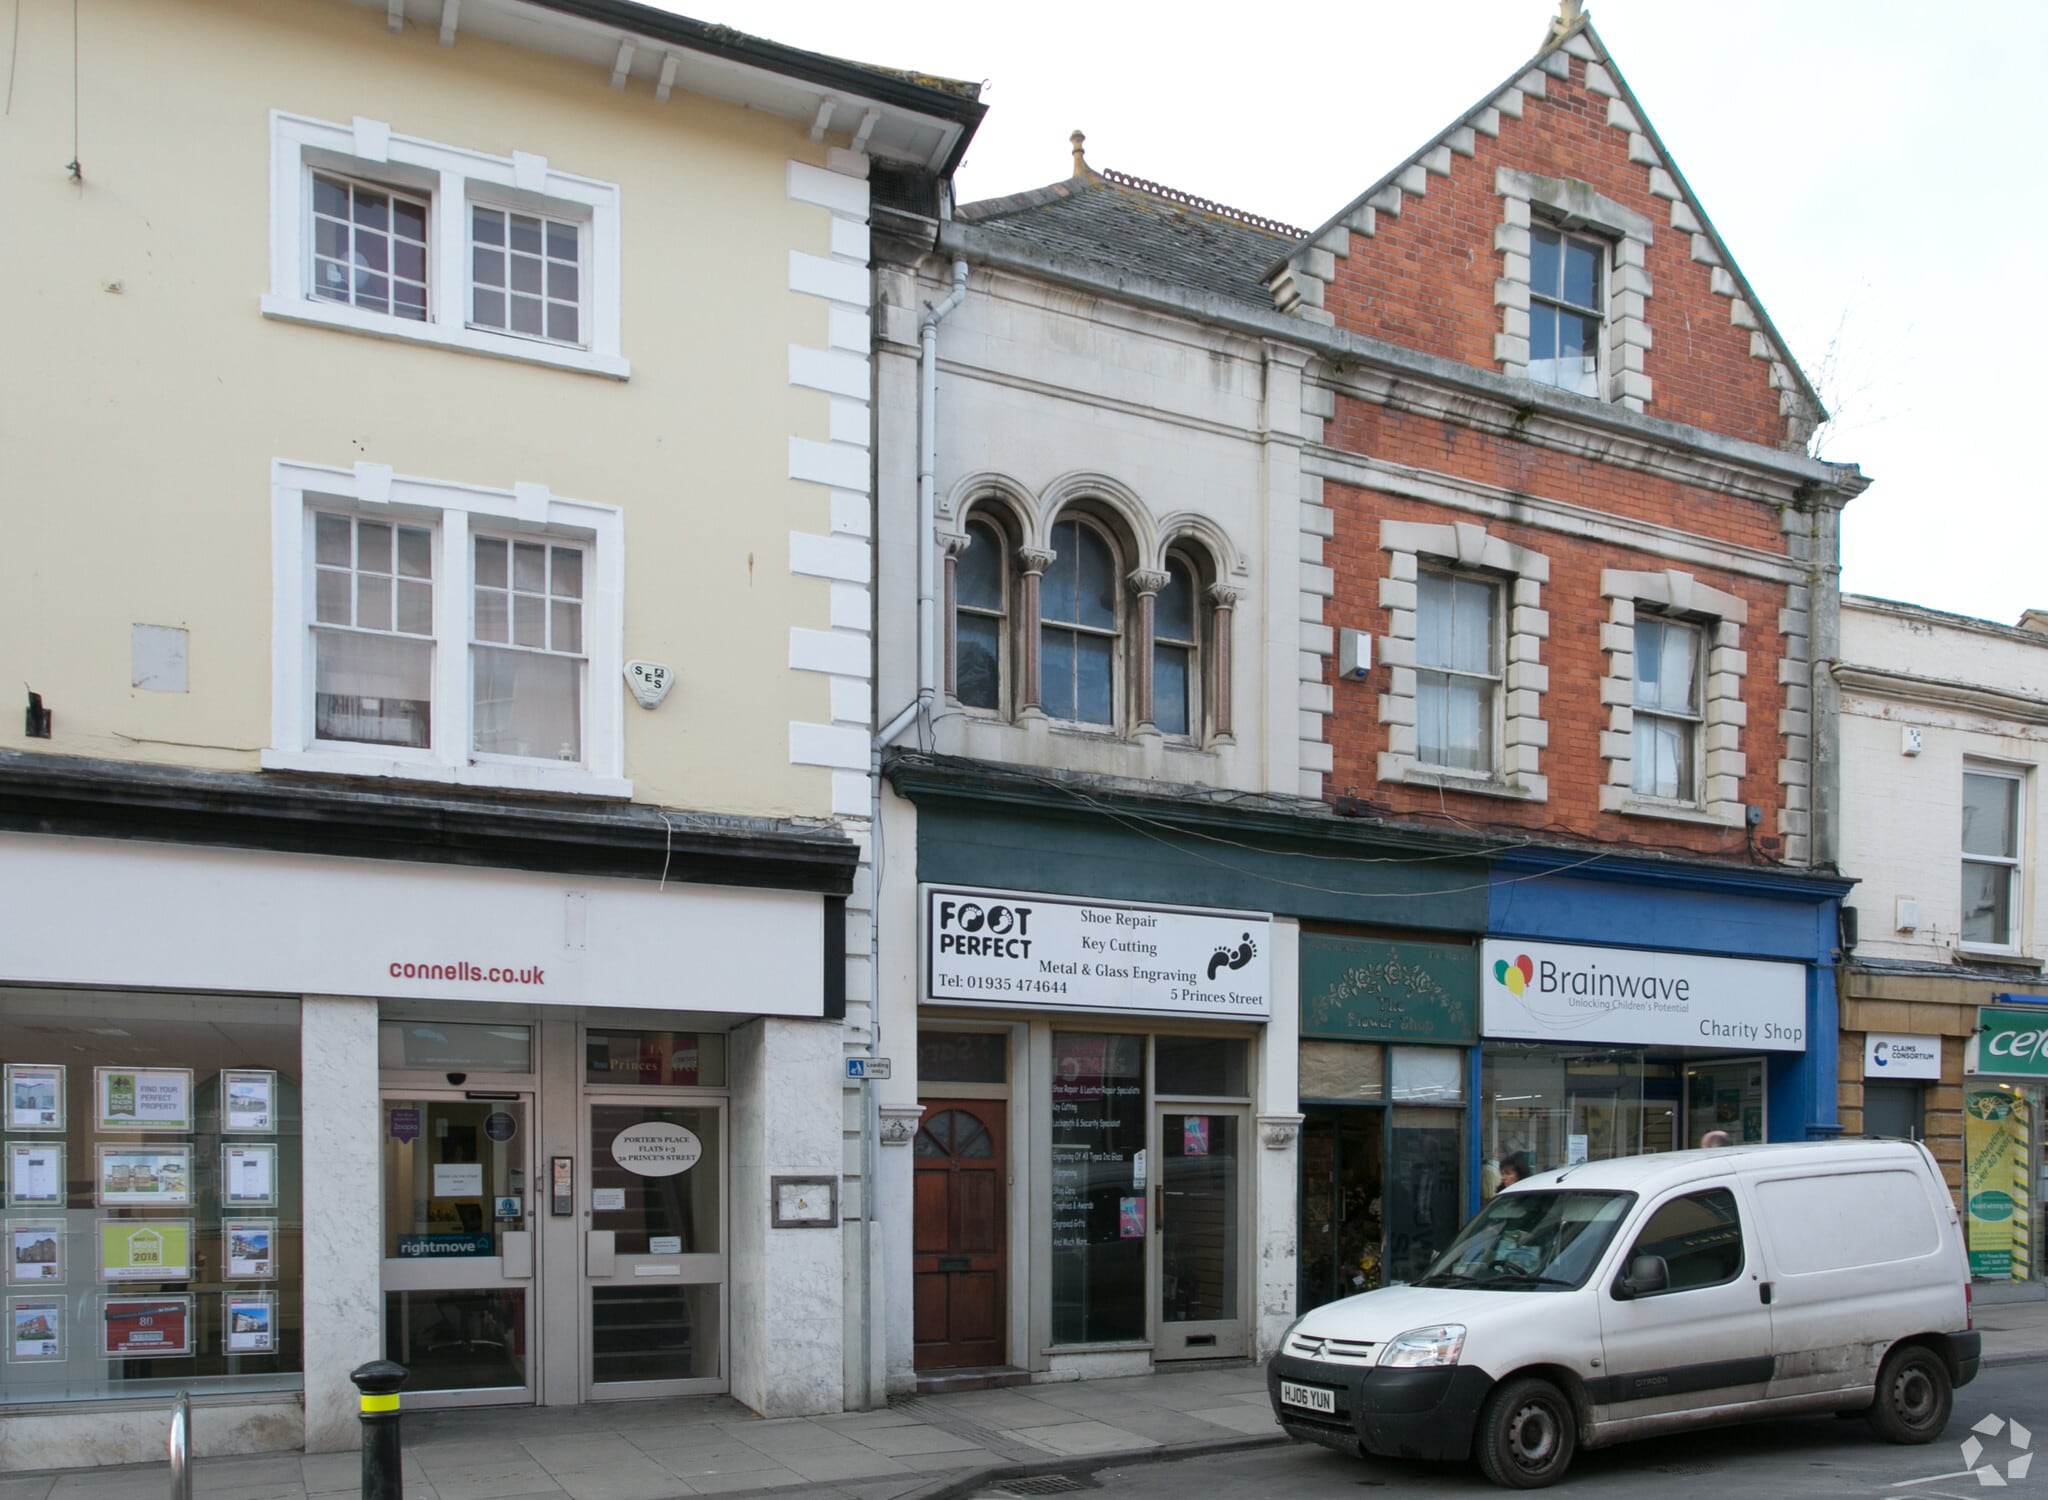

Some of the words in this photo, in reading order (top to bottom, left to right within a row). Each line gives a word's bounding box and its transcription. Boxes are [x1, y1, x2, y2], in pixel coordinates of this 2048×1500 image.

[940, 901, 1032, 936] FOOT
[1080, 909, 1112, 925] Shoe
[1116, 912, 1158, 930] Repair
[940, 933, 1032, 959] PERFECT
[1082, 936, 1106, 954] Key
[1110, 938, 1158, 957] Cutting
[389, 961, 545, 985] connells.co.uk
[1039, 960, 1077, 975] Metal
[1081, 964, 1092, 976] &
[1095, 963, 1129, 978] Glass
[1133, 966, 1197, 985] Engraving
[1540, 960, 1690, 1001] Brainwave
[939, 973, 964, 988] Tel:
[967, 975, 1012, 991] 01935
[1016, 979, 1068, 994] 474644
[1170, 988, 1178, 1000] 5
[1182, 989, 1226, 1003] Princes
[1228, 991, 1263, 1005] Street
[1568, 998, 1610, 1010] Unlocking
[1611, 999, 1652, 1011] Children's
[1654, 1001, 1689, 1013] Potential
[1699, 1018, 1759, 1042] Charity
[1764, 1022, 1803, 1044] Shop
[1891, 1044, 1917, 1052] CLAIMS
[1891, 1052, 1935, 1060] CONSORTIUM
[1988, 1027, 2048, 1064] cer
[610, 1059, 658, 1071] Princes
[159, 1086, 178, 1094] YOUR
[1969, 1126, 2006, 1175] Celebrating
[1973, 1168, 1989, 1189] over
[1987, 1154, 1998, 1169] 40
[133, 1252, 158, 1261] 2018
[401, 1240, 476, 1256] rightmove
[139, 1316, 153, 1326] 80
[1284, 1384, 1308, 1405] HJ06
[1310, 1390, 1330, 1410] YUN
